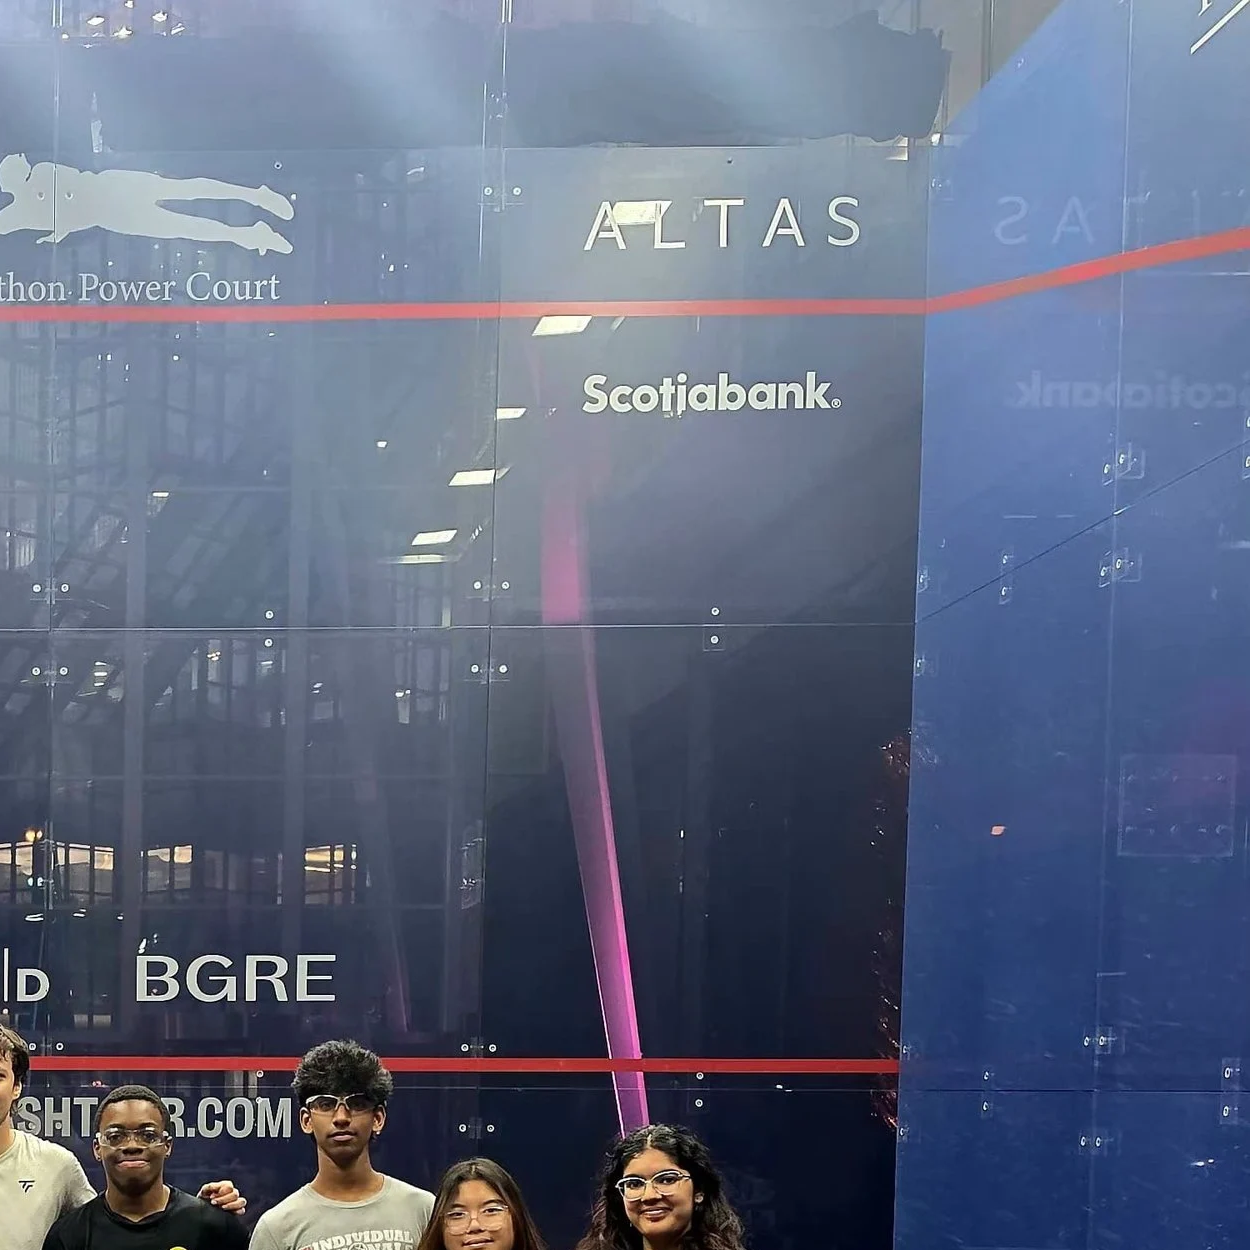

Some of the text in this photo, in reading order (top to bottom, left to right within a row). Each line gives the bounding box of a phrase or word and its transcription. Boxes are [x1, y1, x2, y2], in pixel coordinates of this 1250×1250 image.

[583, 196, 861, 251] ALTAS
[77, 272, 177, 302] Power
[186, 271, 281, 302] Court
[135, 954, 337, 1002] BGRE
